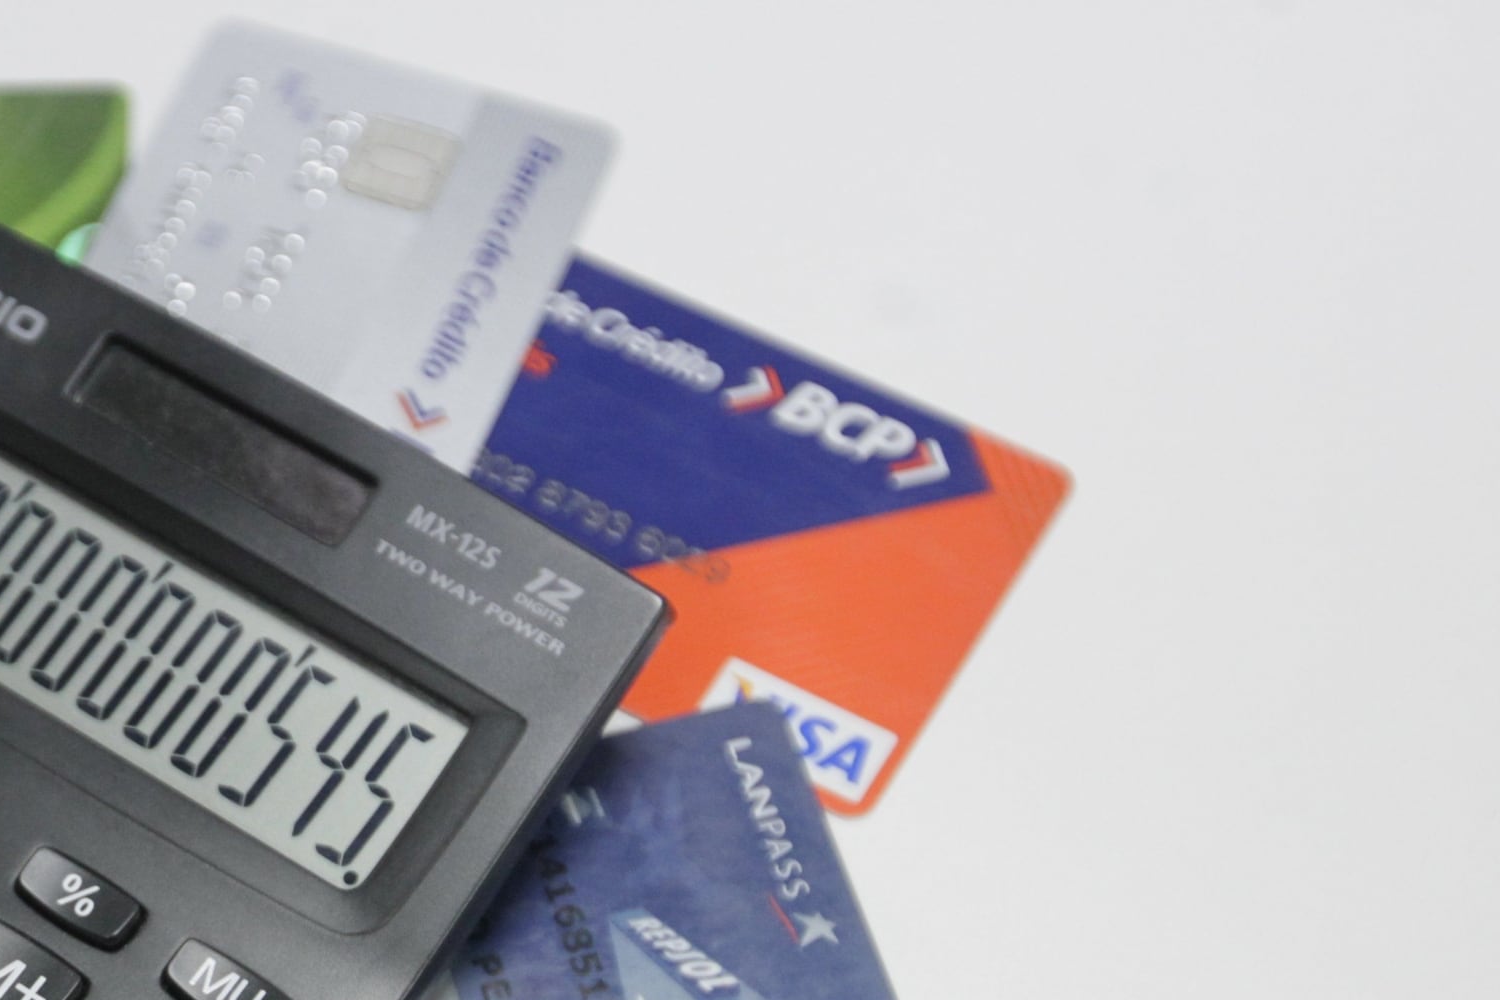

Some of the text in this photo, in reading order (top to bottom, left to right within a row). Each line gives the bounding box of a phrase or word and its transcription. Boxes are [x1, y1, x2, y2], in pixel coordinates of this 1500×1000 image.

[586, 307, 725, 392] Crédito
[771, 380, 917, 462] BCP
[406, 504, 501, 569] MX-12S
[377, 538, 565, 656] TWO WAY POWER
[513, 591, 568, 628] DIGITS
[523, 567, 585, 613] 12
[726, 737, 810, 901] LANPASS
[627, 915, 741, 994] REPSOL
